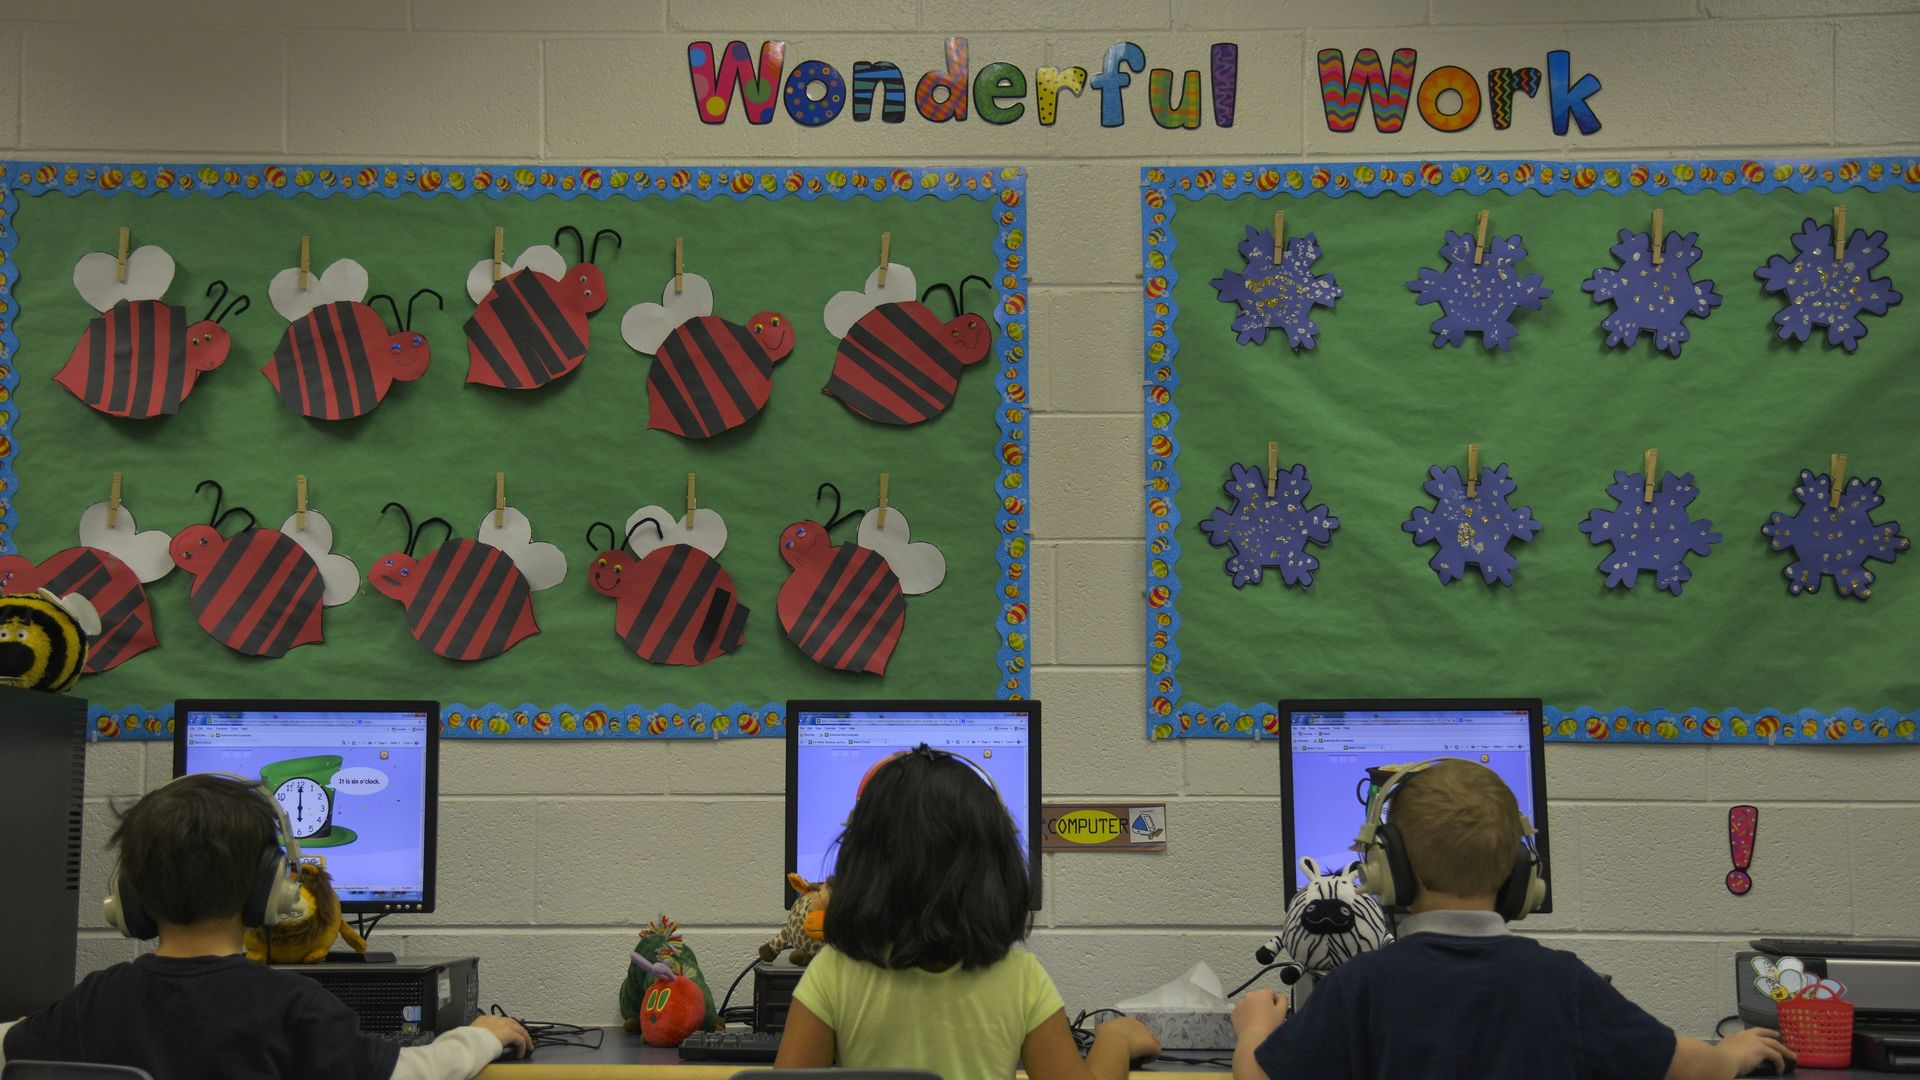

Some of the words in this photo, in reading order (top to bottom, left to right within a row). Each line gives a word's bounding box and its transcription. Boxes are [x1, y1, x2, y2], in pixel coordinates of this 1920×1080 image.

[687, 37, 1238, 129] Wonderful
[1317, 48, 1602, 136] Work
[297, 781, 305, 789] 12
[277, 793, 286, 801] 10
[317, 793, 323, 801] 2
[320, 805, 325, 813] 3
[308, 825, 314, 833] 5
[1047, 818, 1129, 834] COMPUTER
